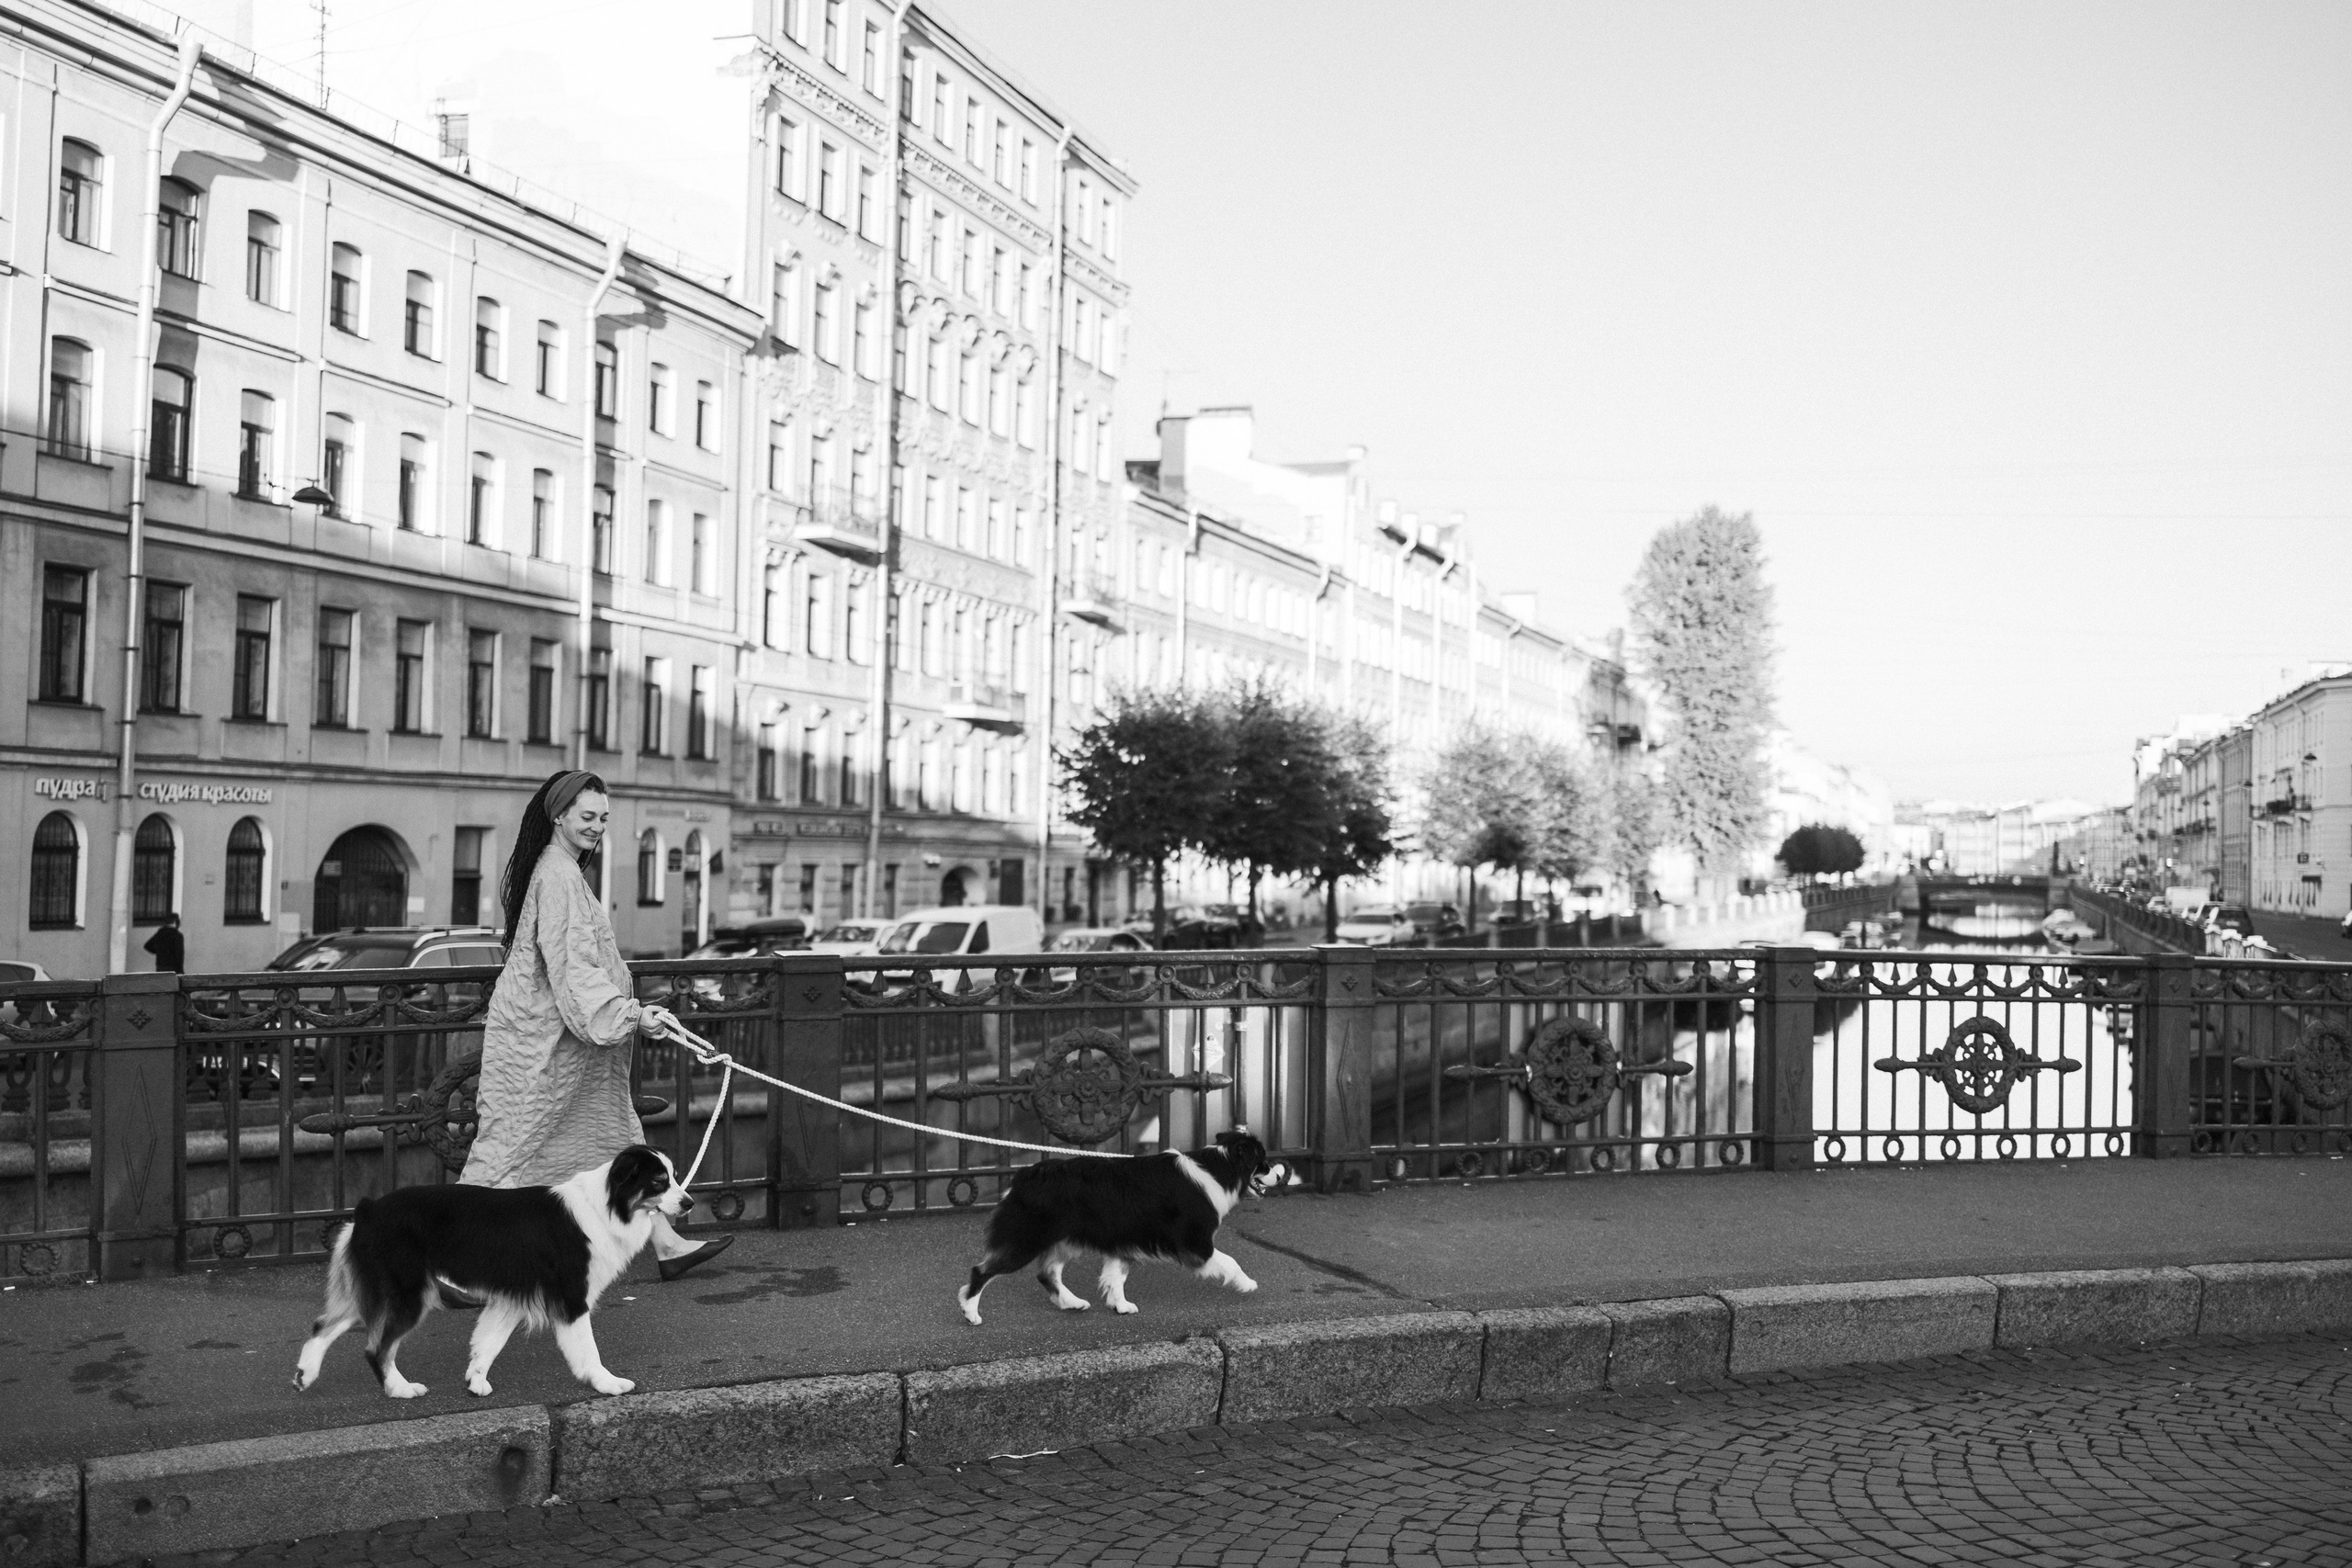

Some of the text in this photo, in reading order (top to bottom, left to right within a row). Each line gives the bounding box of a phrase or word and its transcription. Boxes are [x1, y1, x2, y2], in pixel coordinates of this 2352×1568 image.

[36, 778, 96, 800] пудра
[140, 783, 272, 805] студия красоты
